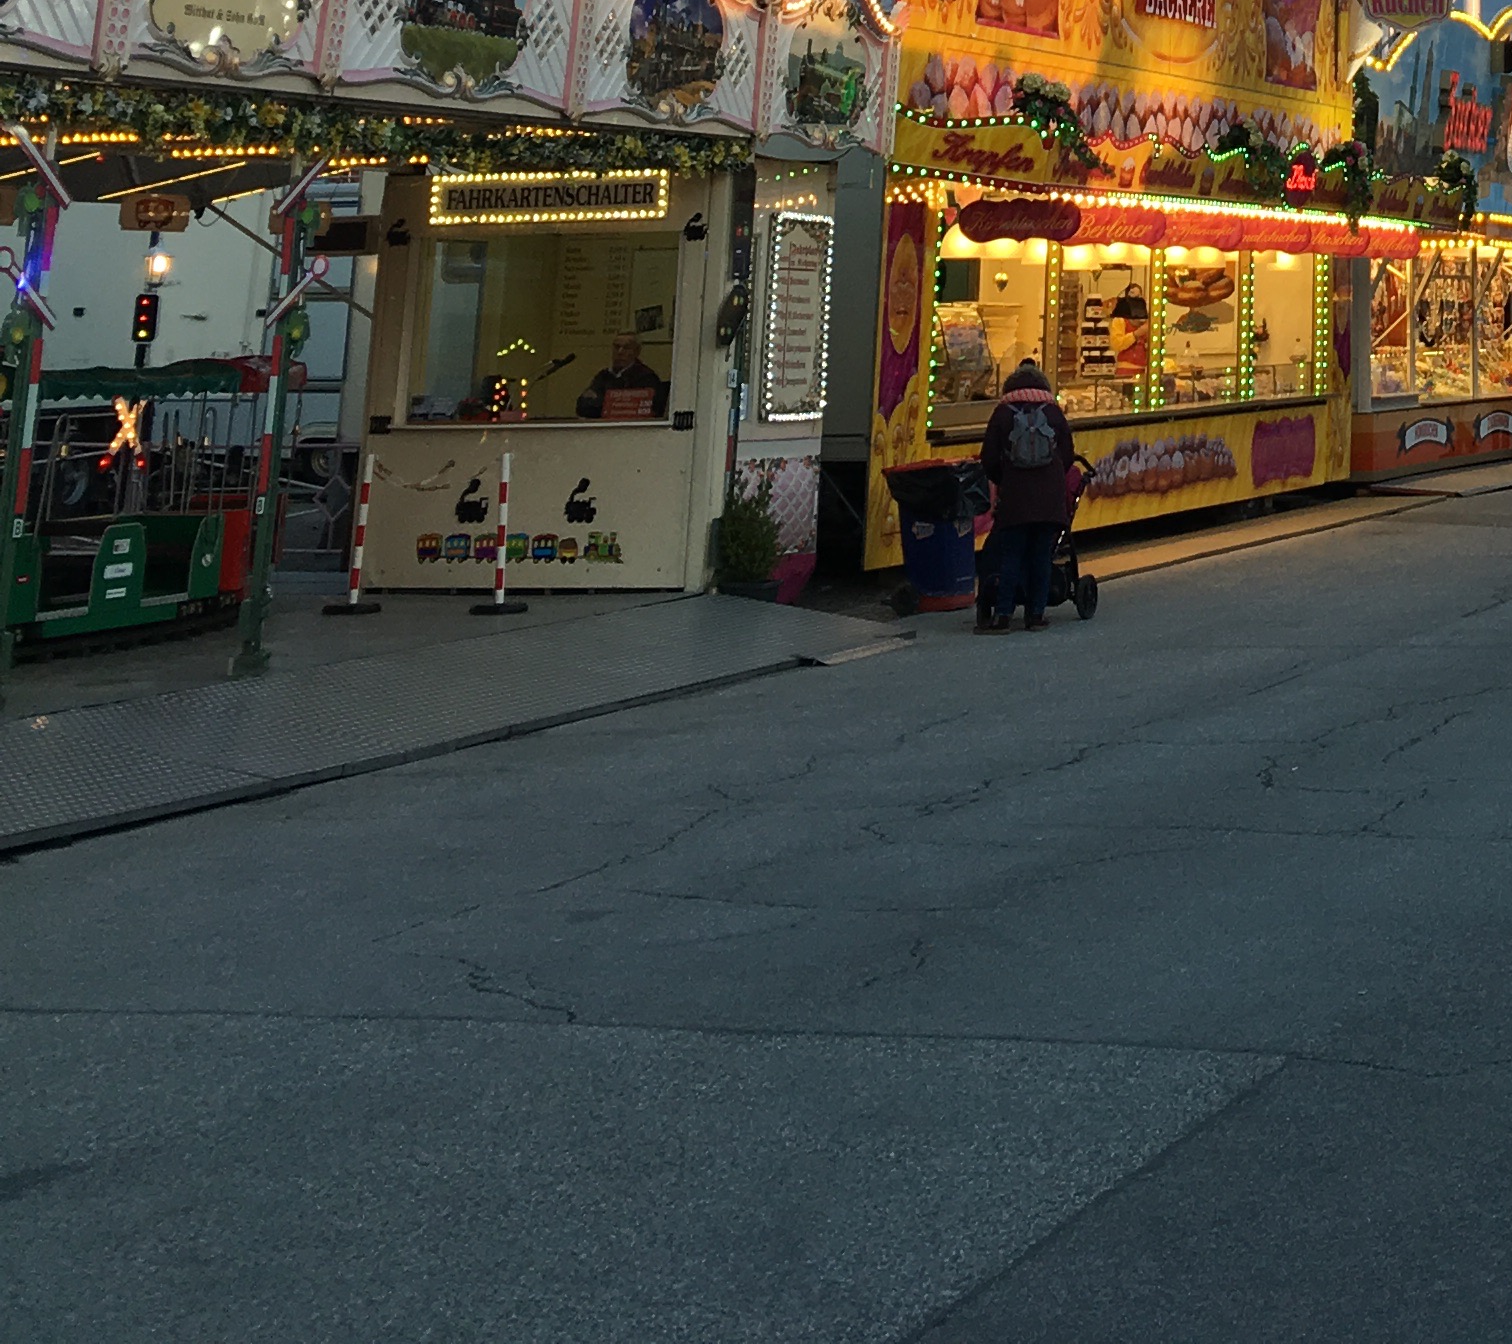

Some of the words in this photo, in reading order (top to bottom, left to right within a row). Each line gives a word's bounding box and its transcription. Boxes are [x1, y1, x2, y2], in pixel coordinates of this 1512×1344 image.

[932, 130, 1035, 175] Krapfen
[446, 182, 655, 210] FAHRKARTENSCHALTER
[1075, 213, 1153, 240] Berliner
